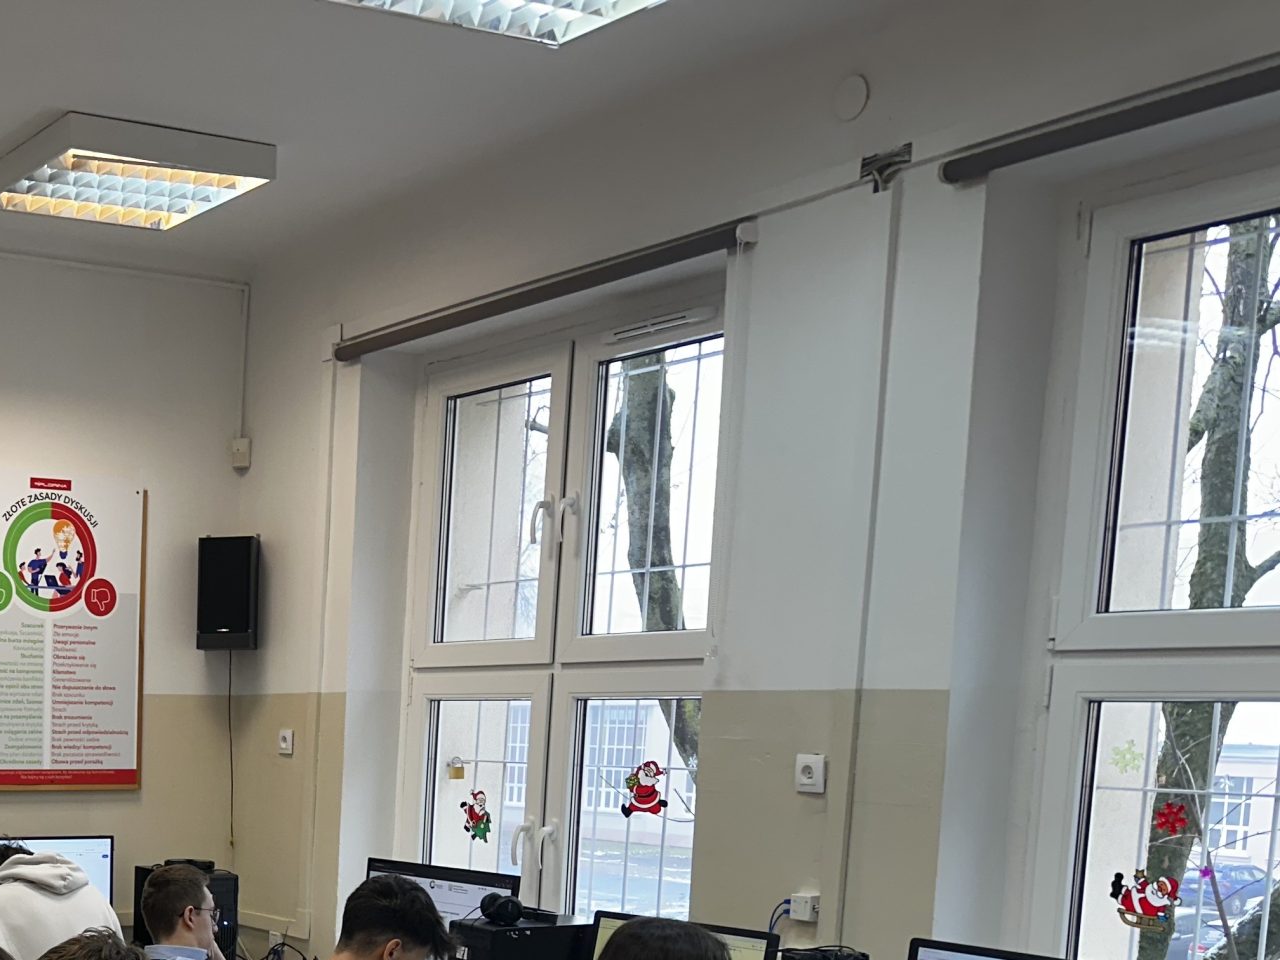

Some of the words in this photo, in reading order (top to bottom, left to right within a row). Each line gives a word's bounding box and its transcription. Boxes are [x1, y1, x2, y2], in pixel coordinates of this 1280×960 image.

[2, 498, 27, 522] ZŁOTE
[27, 492, 63, 504] ZASADY
[63, 495, 99, 528] DYSKUSJI
